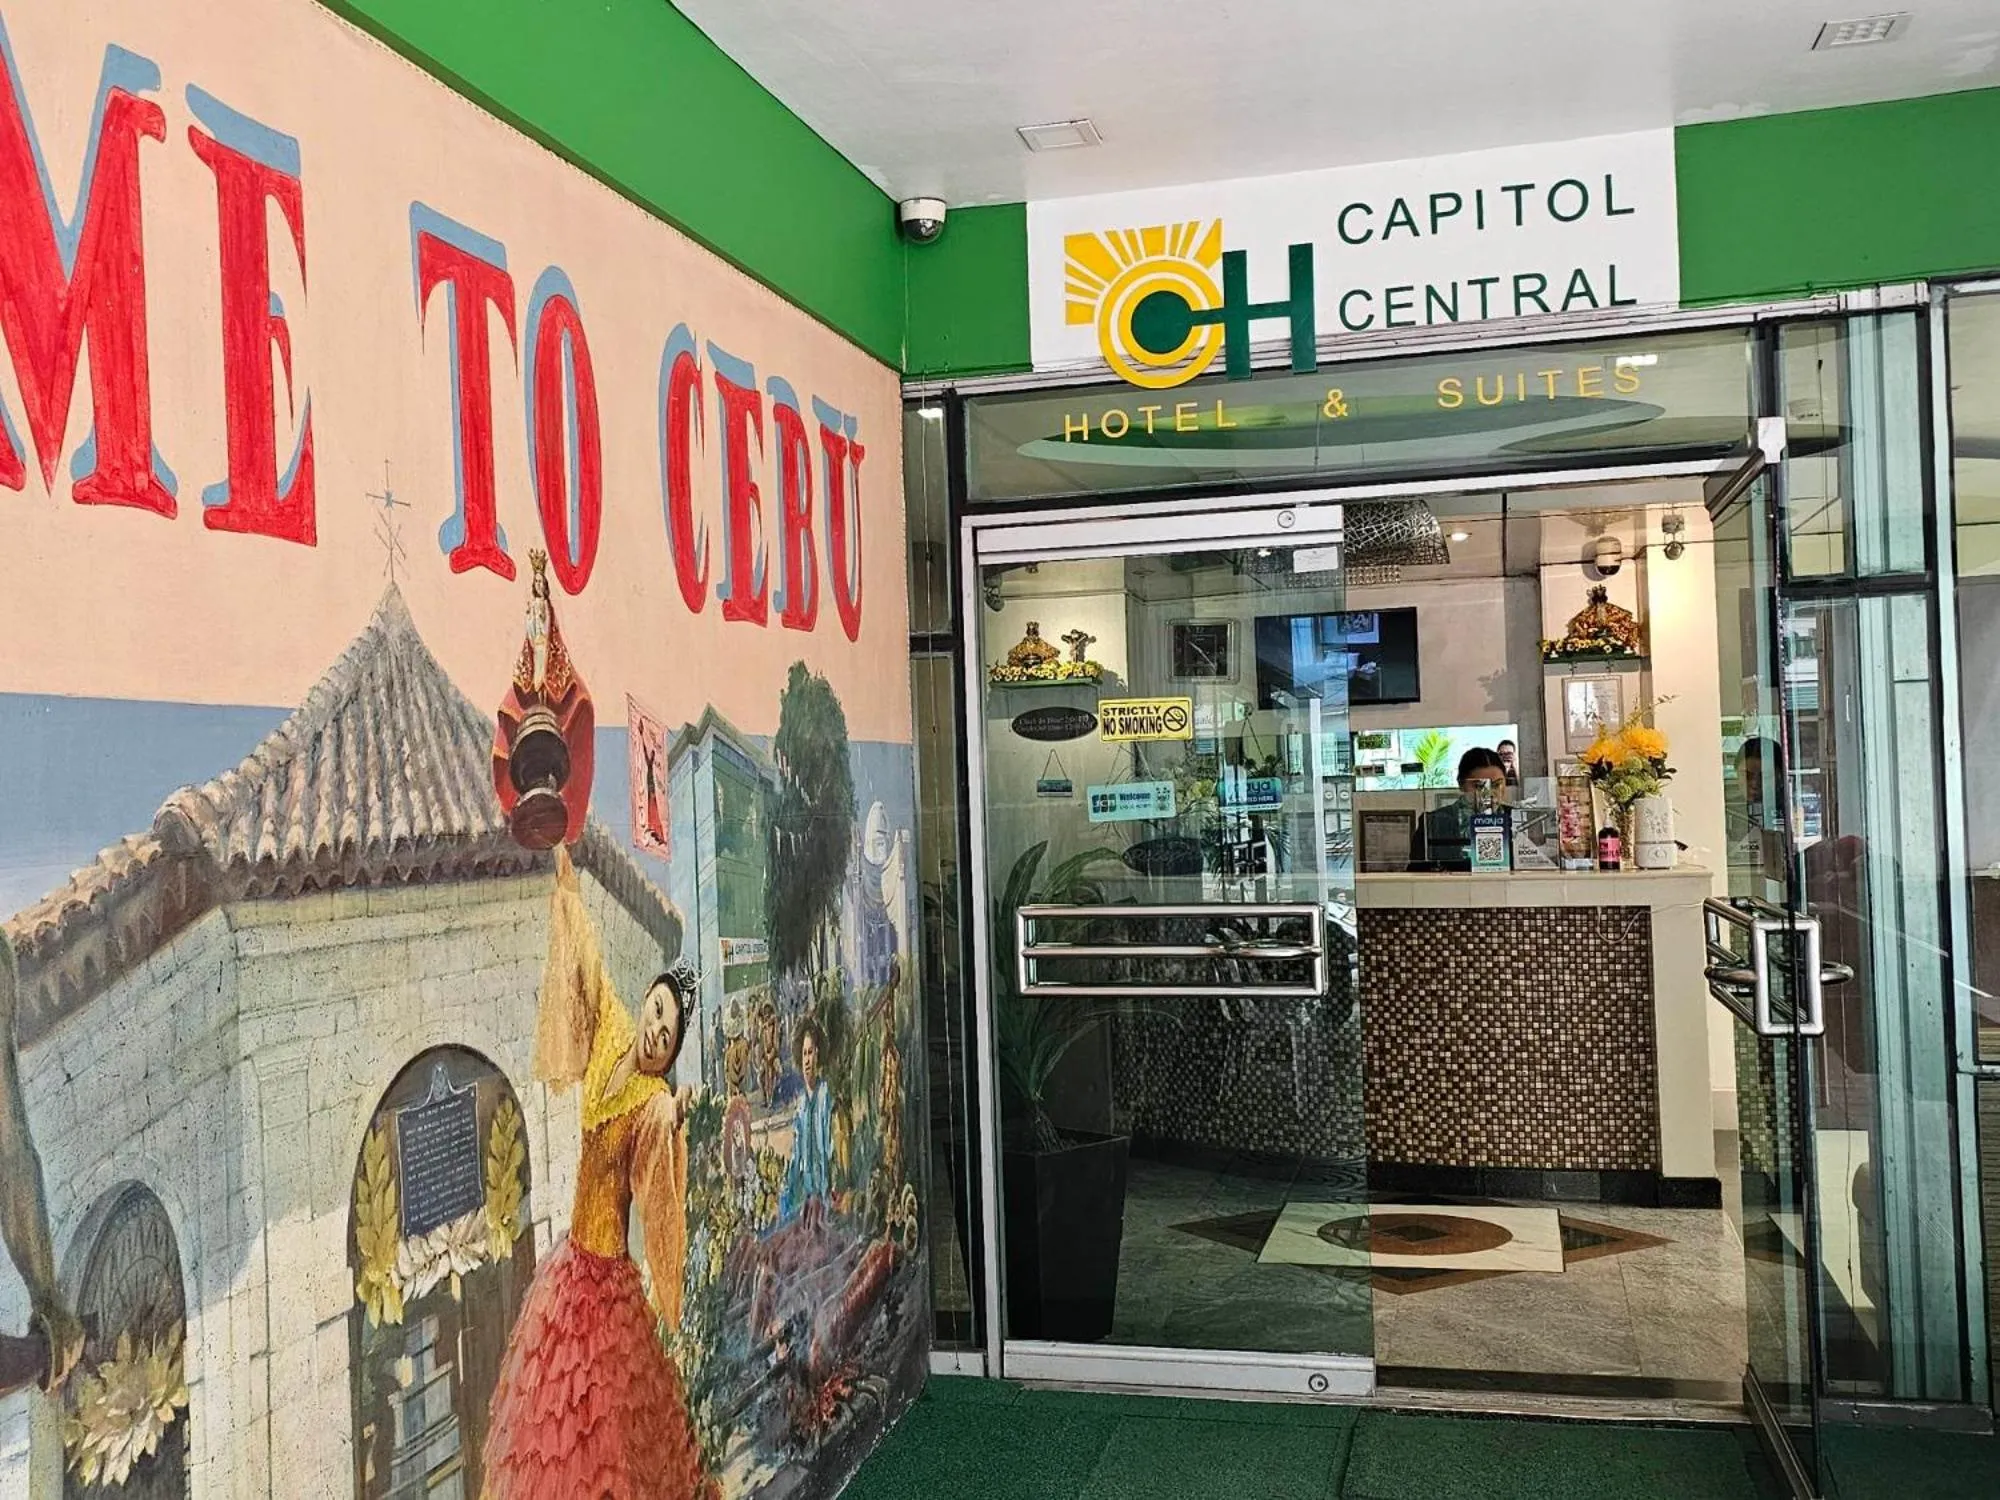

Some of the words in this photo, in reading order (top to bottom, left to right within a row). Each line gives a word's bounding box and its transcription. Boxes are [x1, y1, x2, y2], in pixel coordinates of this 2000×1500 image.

[1337, 174, 1635, 245] CAPITOL
[1338, 264, 1638, 332] CENTRAL
[410, 200, 603, 596] TO
[658, 322, 865, 643] CEBU
[1064, 399, 1238, 442] HOTEL
[1323, 388, 1348, 418] &
[1437, 363, 1641, 408] SUITES
[1103, 705, 1161, 717] STRICTLY
[1103, 717, 1117, 735] NO
[1118, 715, 1162, 735] SMOKING
[1473, 816, 1504, 826] maya
